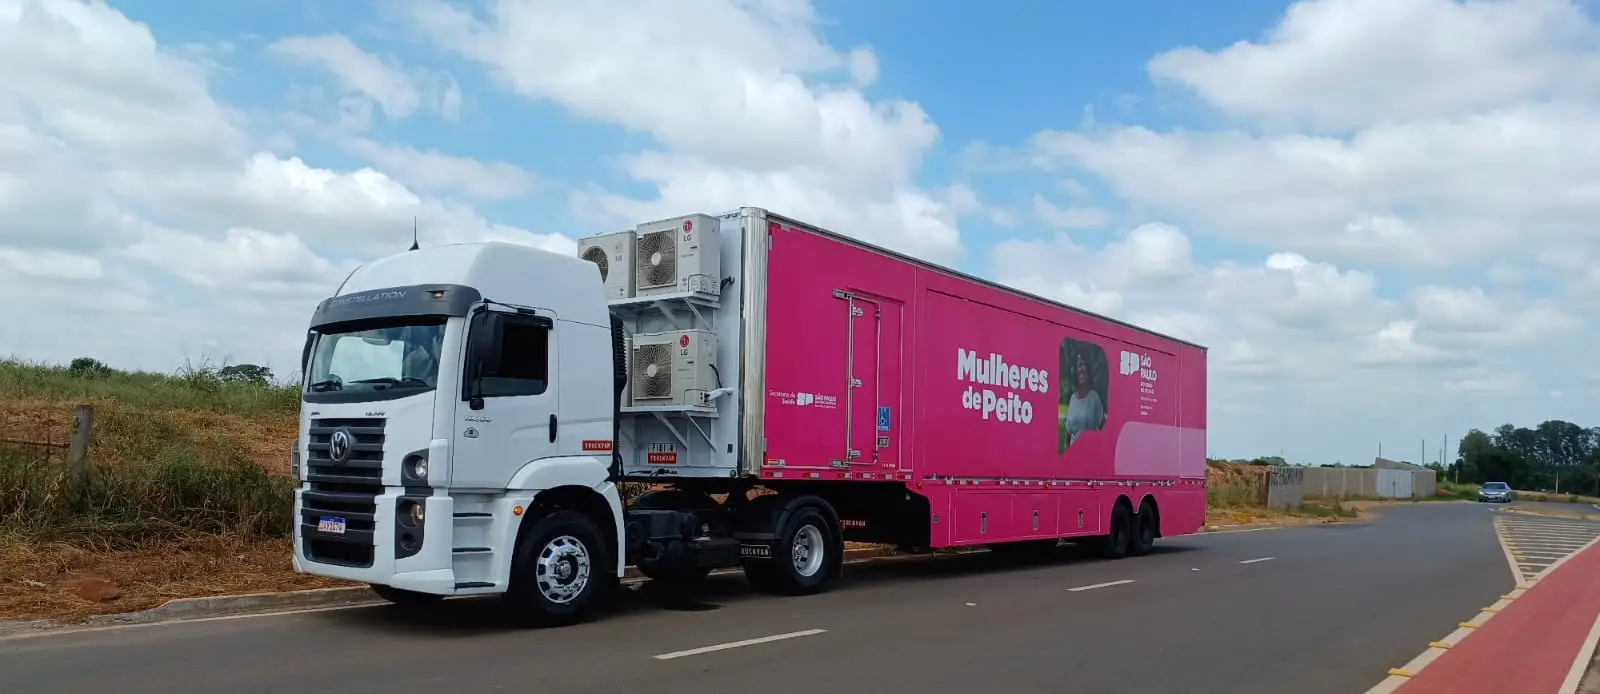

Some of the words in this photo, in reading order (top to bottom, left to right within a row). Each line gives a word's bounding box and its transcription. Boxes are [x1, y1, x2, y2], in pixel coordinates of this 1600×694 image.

[957, 348, 1049, 393] Mulheres
[1141, 352, 1152, 368] SÃO
[1141, 367, 1158, 381] PAULO
[962, 386, 982, 410] de
[982, 389, 1033, 424] Peito
